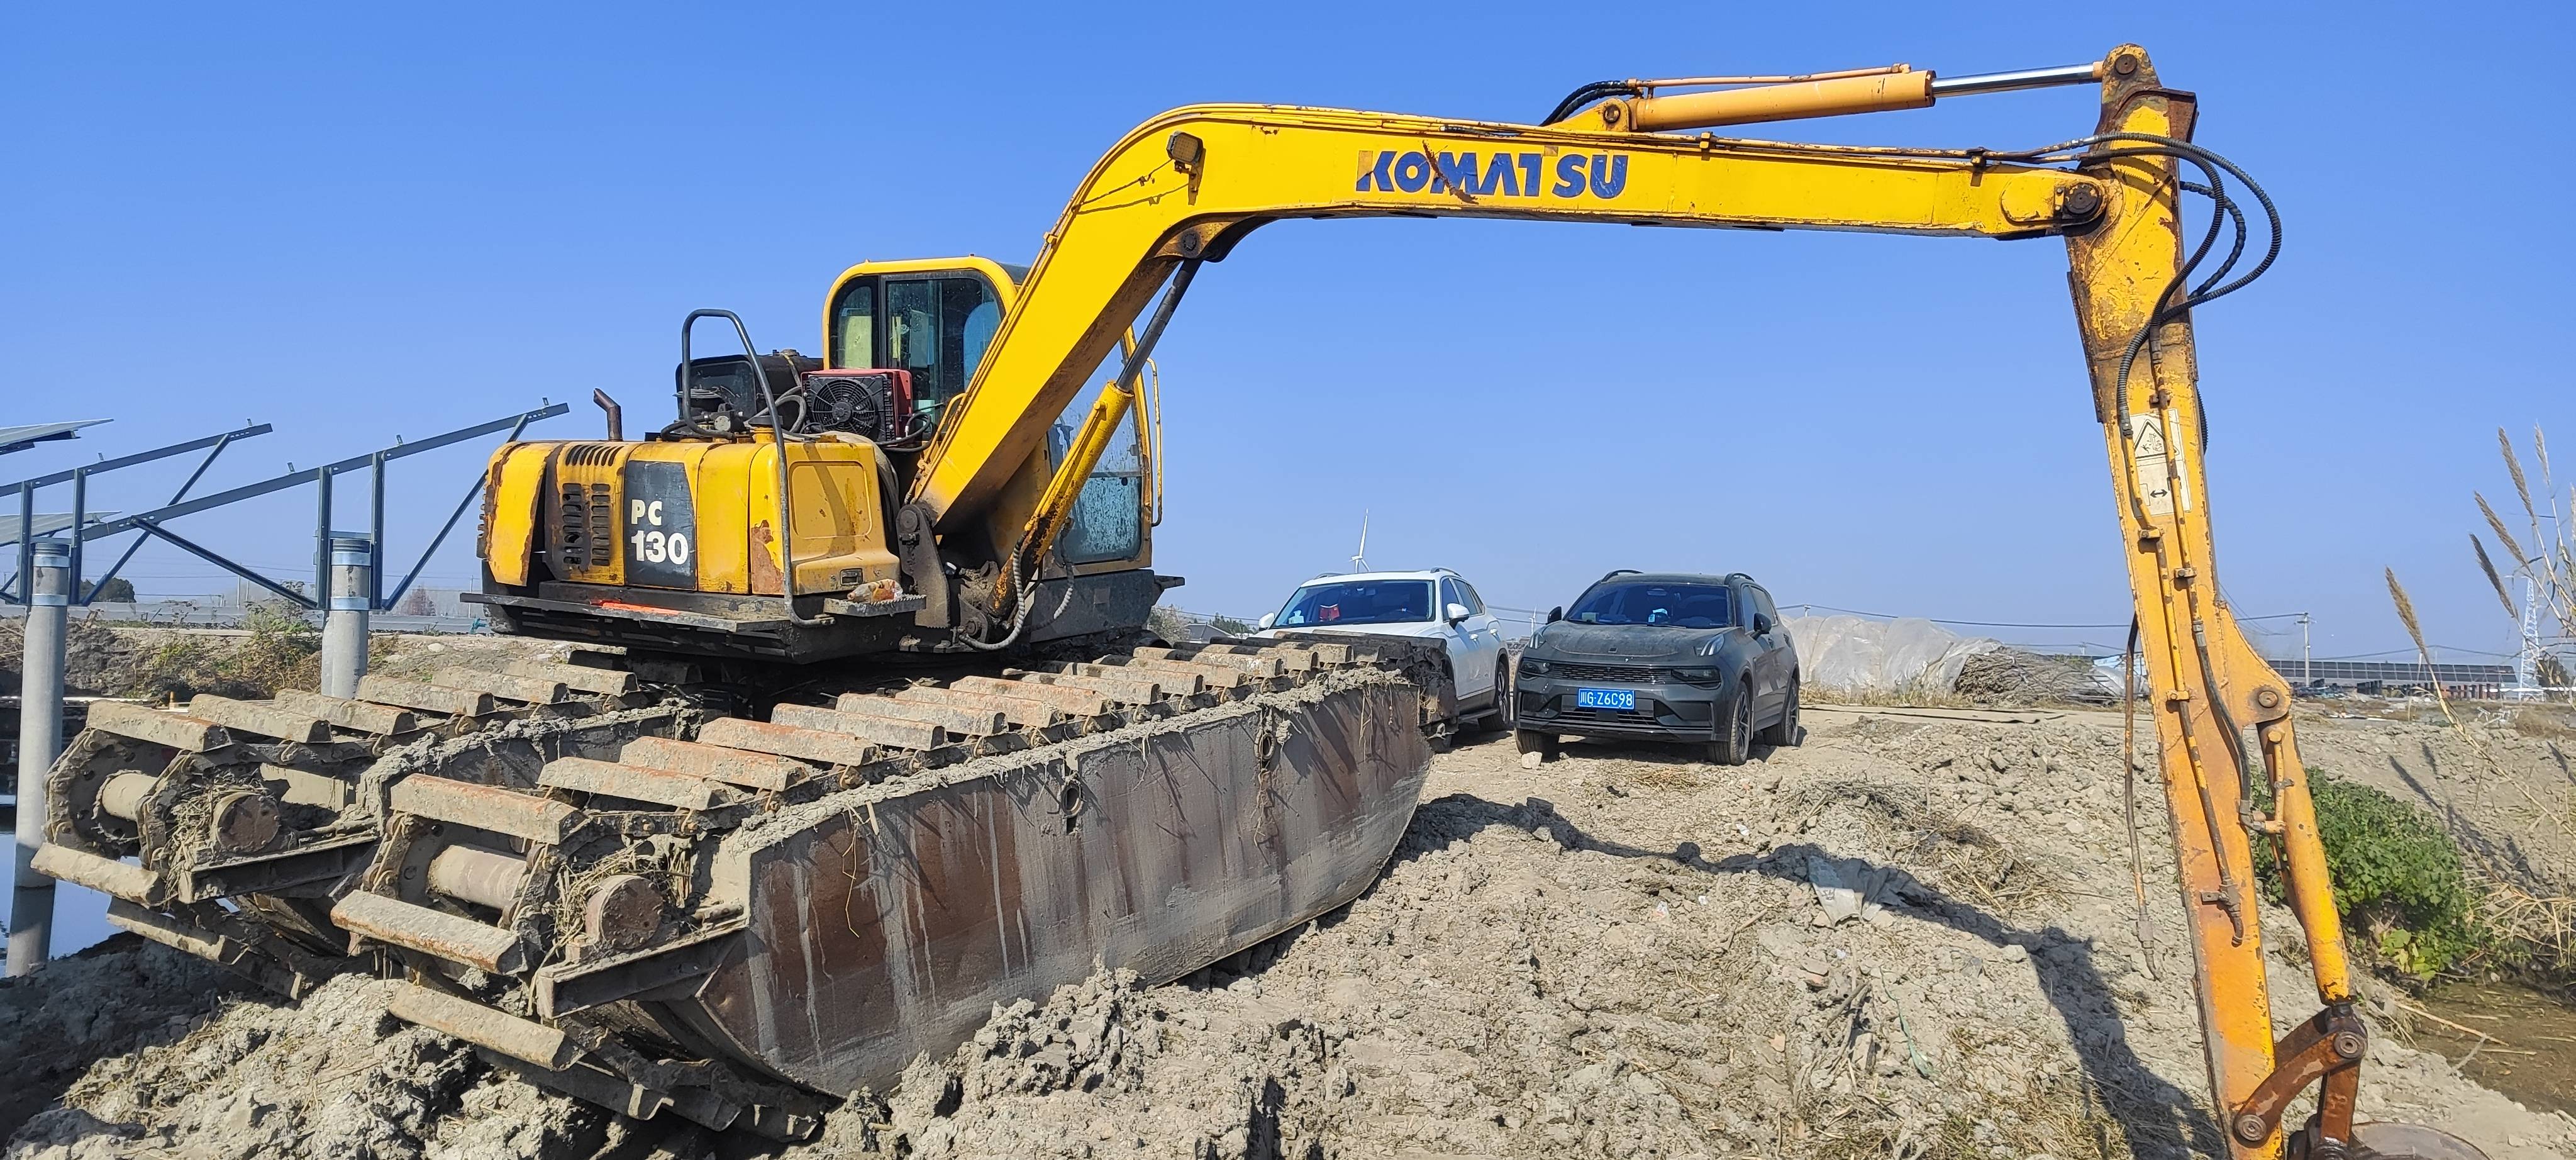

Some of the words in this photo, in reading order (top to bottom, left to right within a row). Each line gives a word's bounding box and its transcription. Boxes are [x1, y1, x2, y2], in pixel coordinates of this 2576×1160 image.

[1356, 150, 1629, 199] KOMATSU
[631, 499, 662, 526] PC
[631, 530, 689, 565] 130
